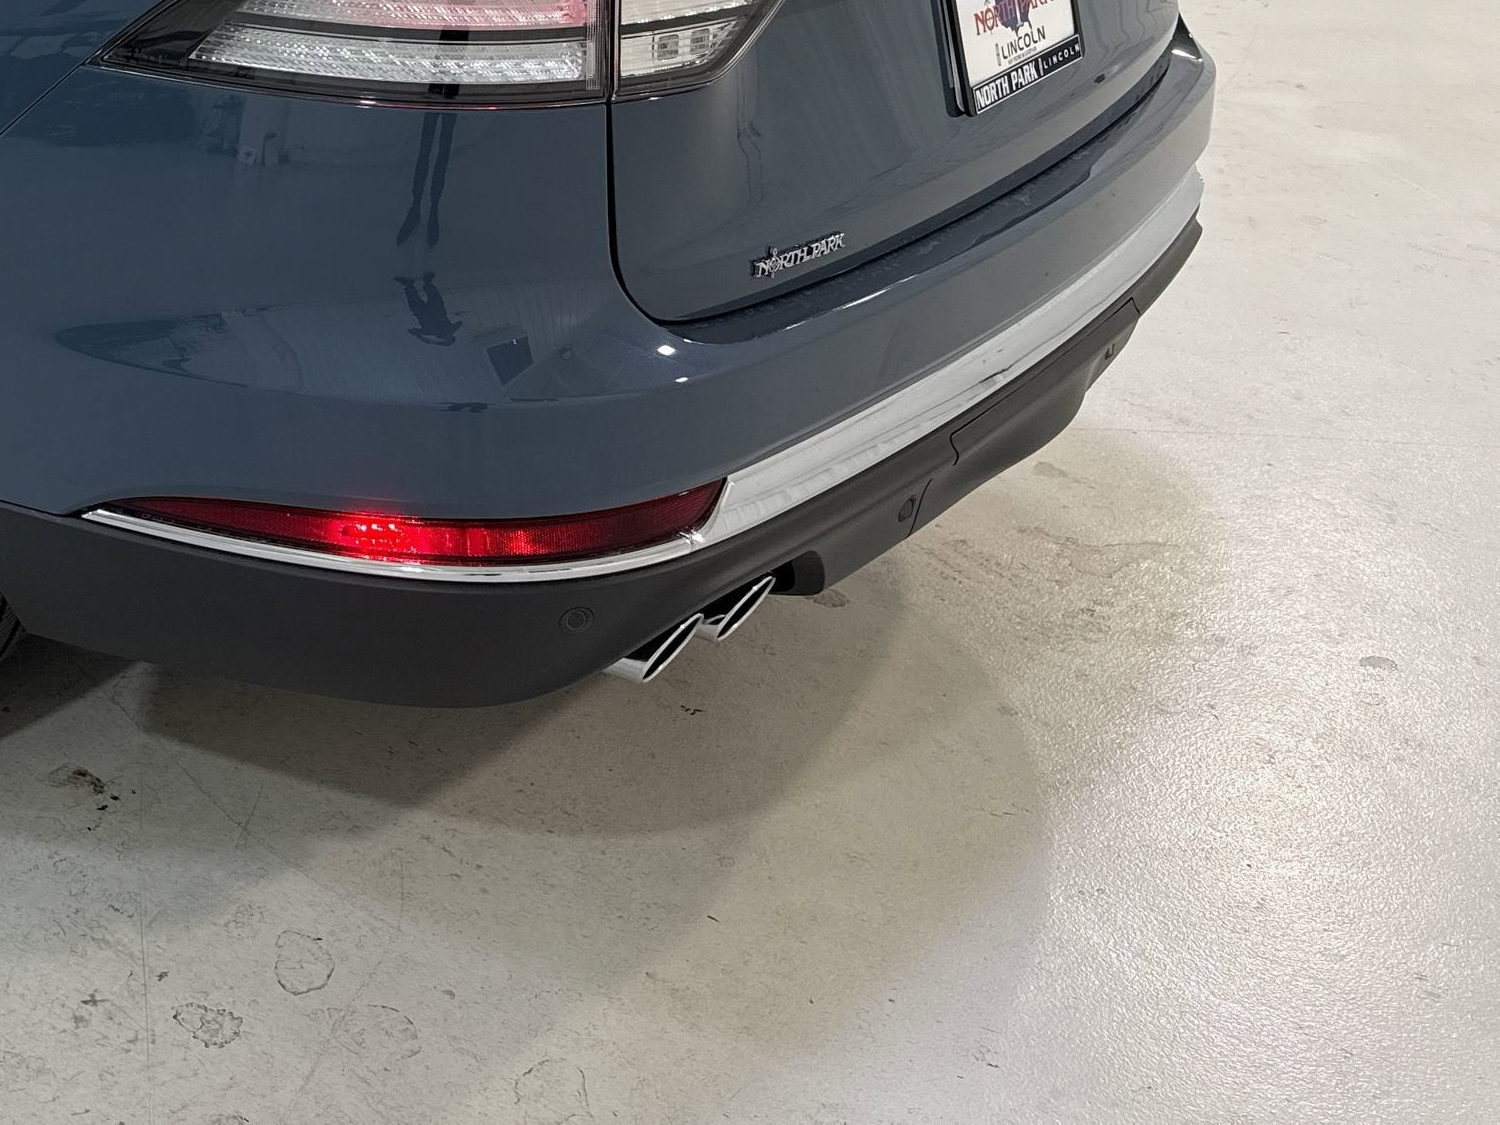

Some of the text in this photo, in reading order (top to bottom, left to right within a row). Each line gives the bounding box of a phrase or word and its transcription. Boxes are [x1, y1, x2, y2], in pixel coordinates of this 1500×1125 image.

[1001, 25, 1046, 60] LINCOLN
[975, 75, 1011, 110] NORTH
[1010, 60, 1039, 91] PARK
[1043, 42, 1080, 69] LINCOLN
[754, 233, 845, 279] NORTH PARK
